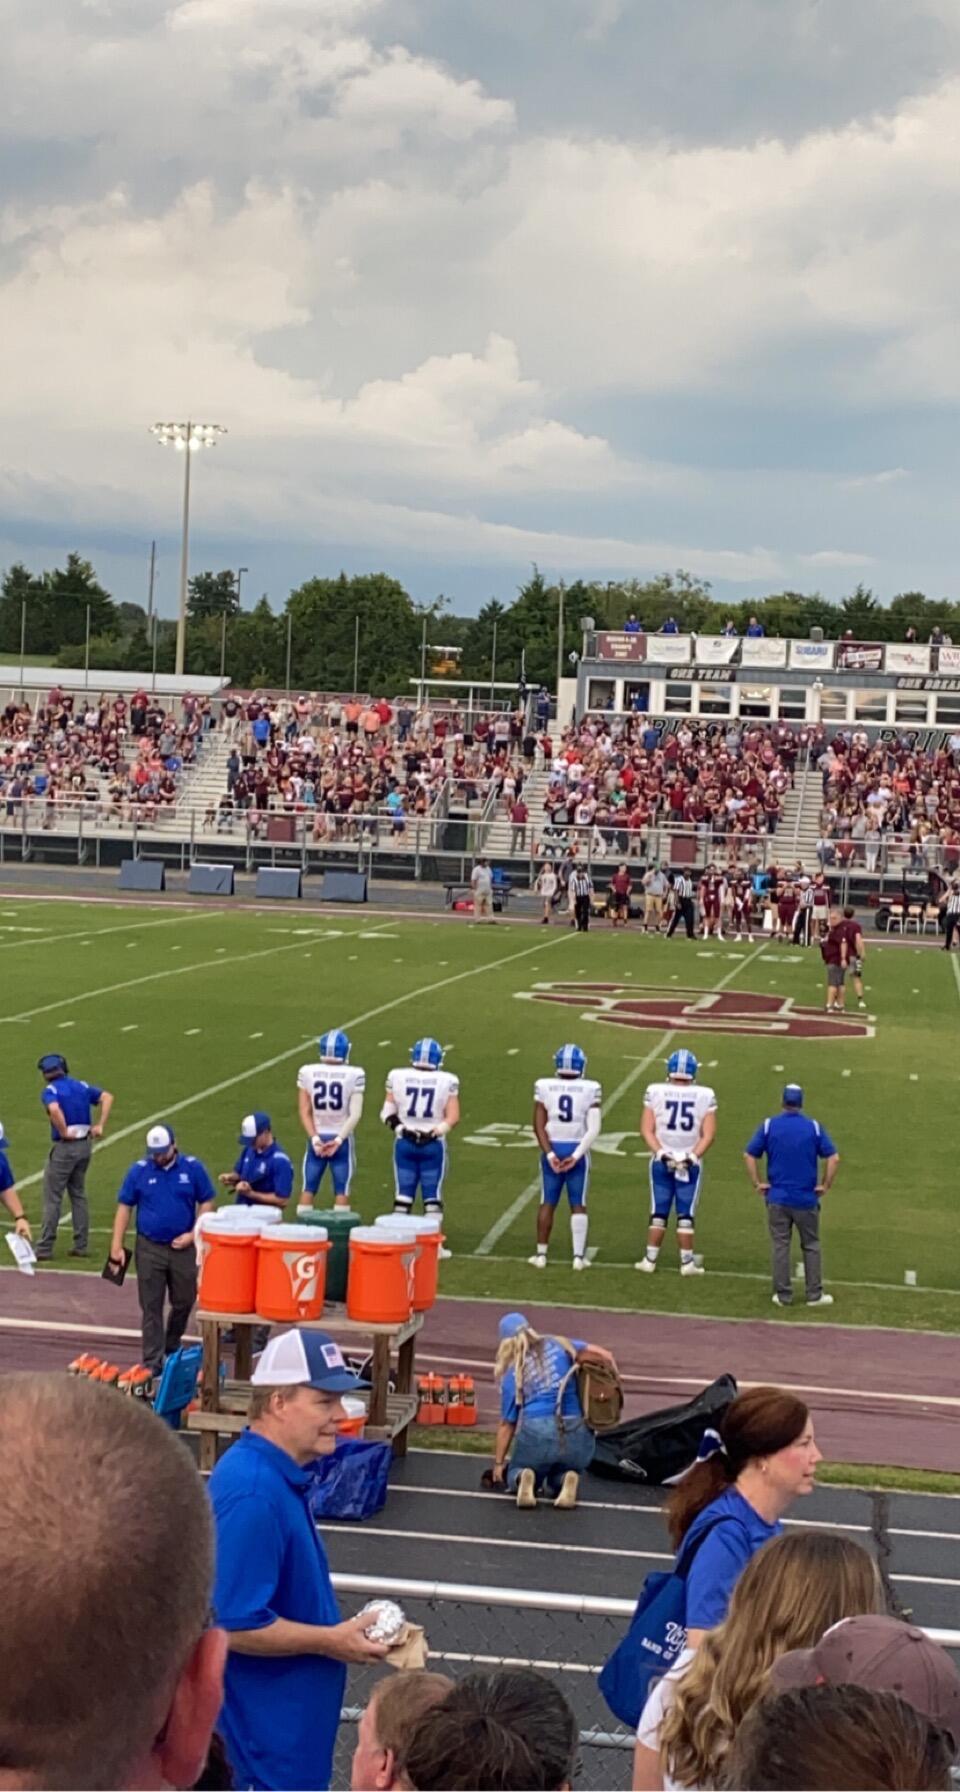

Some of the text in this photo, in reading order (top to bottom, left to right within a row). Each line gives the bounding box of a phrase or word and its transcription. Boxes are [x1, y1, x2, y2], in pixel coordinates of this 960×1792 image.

[796, 645, 828, 656] SUBARU
[670, 668, 732, 681] ONE TEAM
[896, 677, 960, 690] ONE DREA
[313, 1080, 343, 1111] 29
[406, 1086, 435, 1118] 77
[558, 1094, 573, 1122] 9
[665, 1100, 695, 1131] 75
[297, 1256, 315, 1279] G
